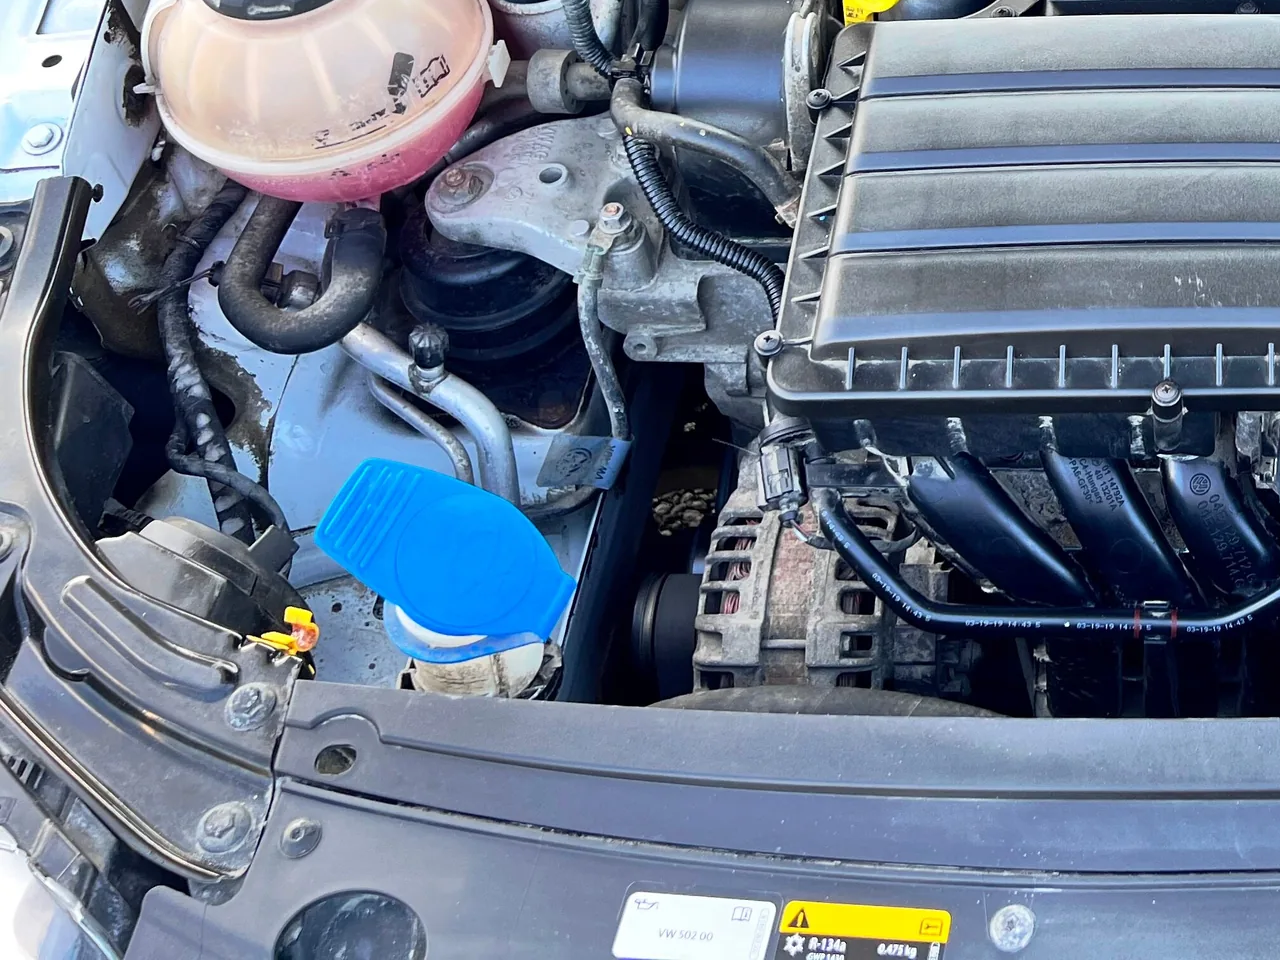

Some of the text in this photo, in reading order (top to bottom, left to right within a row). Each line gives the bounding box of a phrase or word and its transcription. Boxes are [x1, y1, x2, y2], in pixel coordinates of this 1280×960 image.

[1102, 465, 1125, 507] 01 14792A
[1100, 481, 1118, 511] 13201A
[871, 572, 902, 603] 03-19-19
[902, 601, 923, 620] 14:43
[965, 619, 1005, 628] 03-19-19
[1007, 620, 1032, 628] 14:43
[1076, 622, 1115, 630] 03-19-19
[1186, 625, 1222, 633] 03-19-19
[1224, 617, 1246, 630] 14:43
[658, 928, 714, 942] VW 502 00
[808, 937, 847, 952] R-134a
[904, 945, 918, 958] kg
